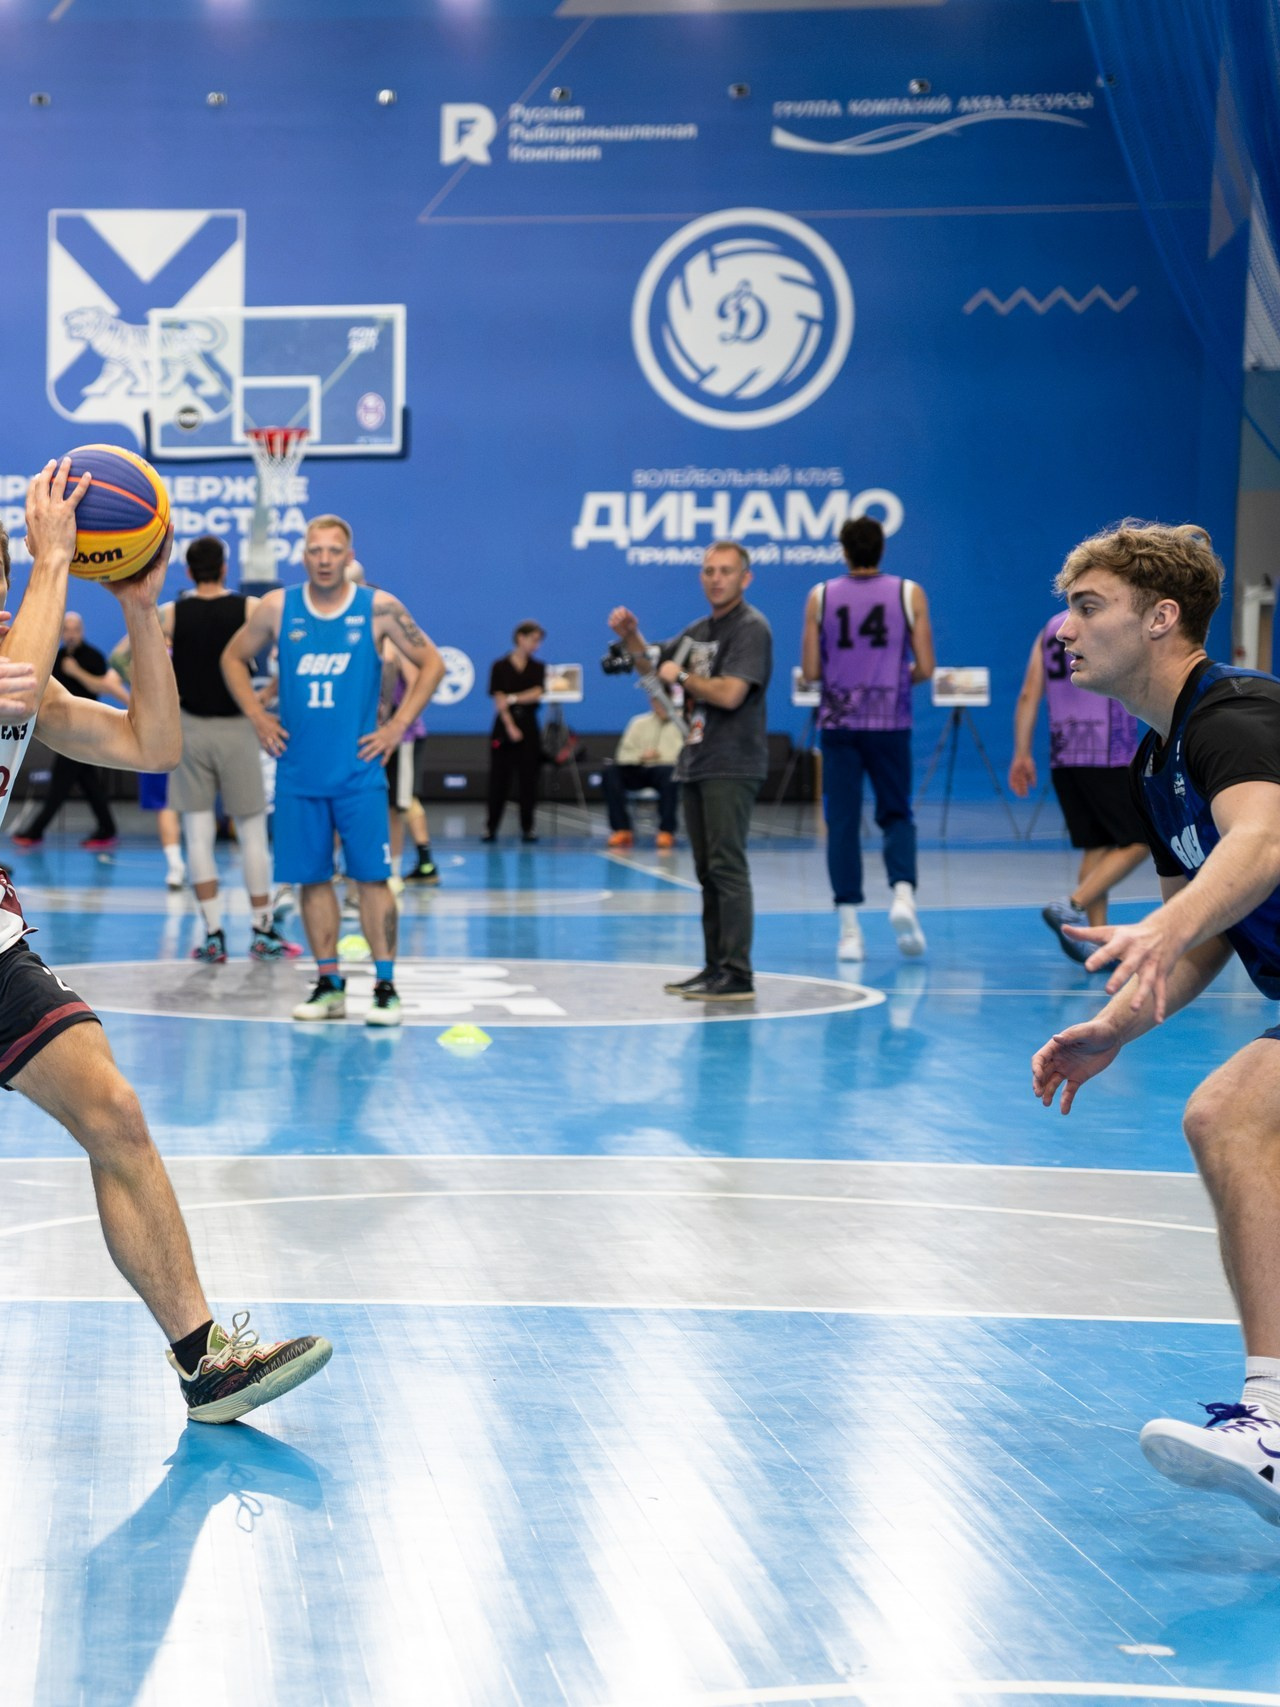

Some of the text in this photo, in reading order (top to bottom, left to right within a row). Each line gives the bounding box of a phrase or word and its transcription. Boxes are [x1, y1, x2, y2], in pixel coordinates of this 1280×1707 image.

[508, 103, 585, 124] Русская
[773, 100, 842, 118] ГРУППА
[847, 94, 952, 116] КОМПАНИЙ
[508, 123, 698, 144] Рыбопромышленная
[508, 145, 602, 162] Компания
[632, 464, 845, 488] ВОЛЕЙБОЛЬНЫЙ КЛУБ
[572, 488, 905, 549] ДИНАМО
[835, 604, 888, 648] 14
[307, 680, 335, 709] 11
